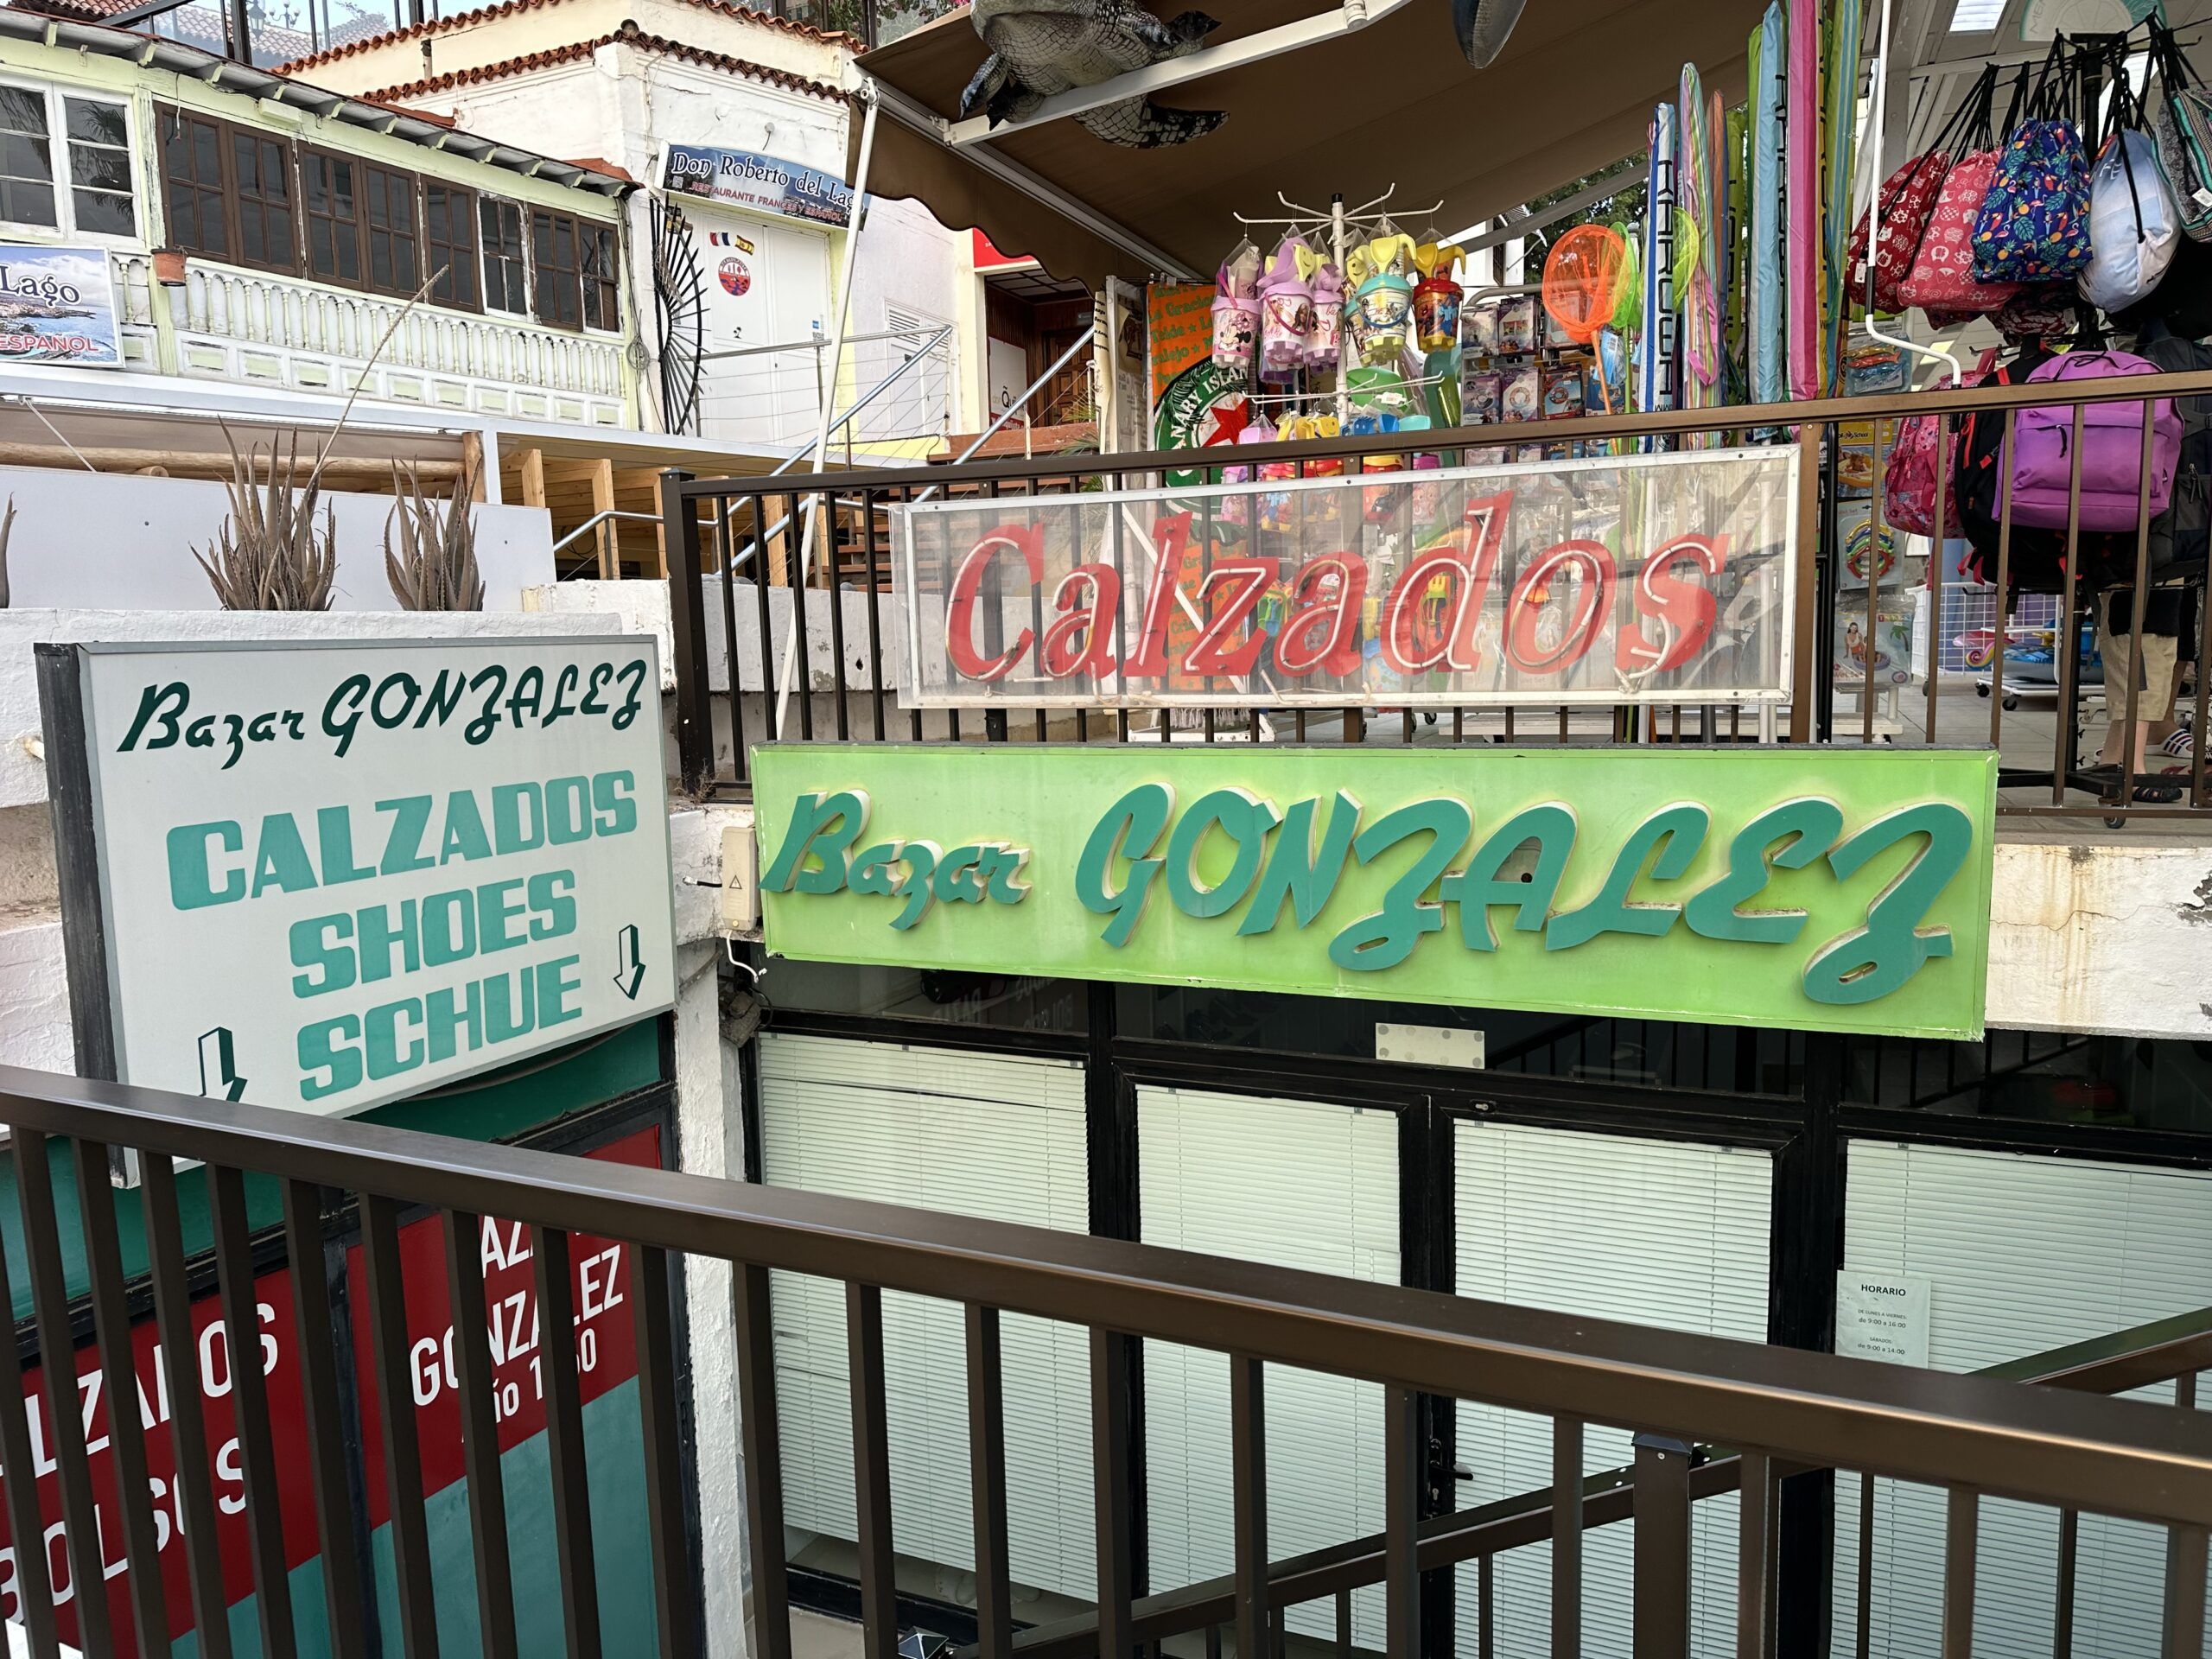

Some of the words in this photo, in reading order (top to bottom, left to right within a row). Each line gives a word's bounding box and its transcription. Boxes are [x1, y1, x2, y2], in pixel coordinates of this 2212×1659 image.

[672, 154, 711, 178] Don
[720, 155, 790, 187] Roberto
[795, 170, 823, 195] del
[827, 181, 865, 213] Lag
[690, 181, 755, 204] RESTAURANTE
[757, 195, 798, 212] FRANCES
[0, 265, 79, 307] Lago
[0, 334, 99, 352] ESPAÑOL
[944, 490, 1732, 678] Calzados
[117, 681, 305, 770] Bazar
[321, 659, 648, 759] GONZALEZ
[166, 770, 638, 911] CALZADOS
[759, 788, 1033, 931] Bazar
[1075, 782, 1973, 1005] GONZALEZ
[289, 869, 577, 999] SHOES
[296, 954, 582, 1102] SCHUE
[410, 1244, 624, 1407] GNZEZ
[1860, 1283, 1906, 1297] HORARIO
